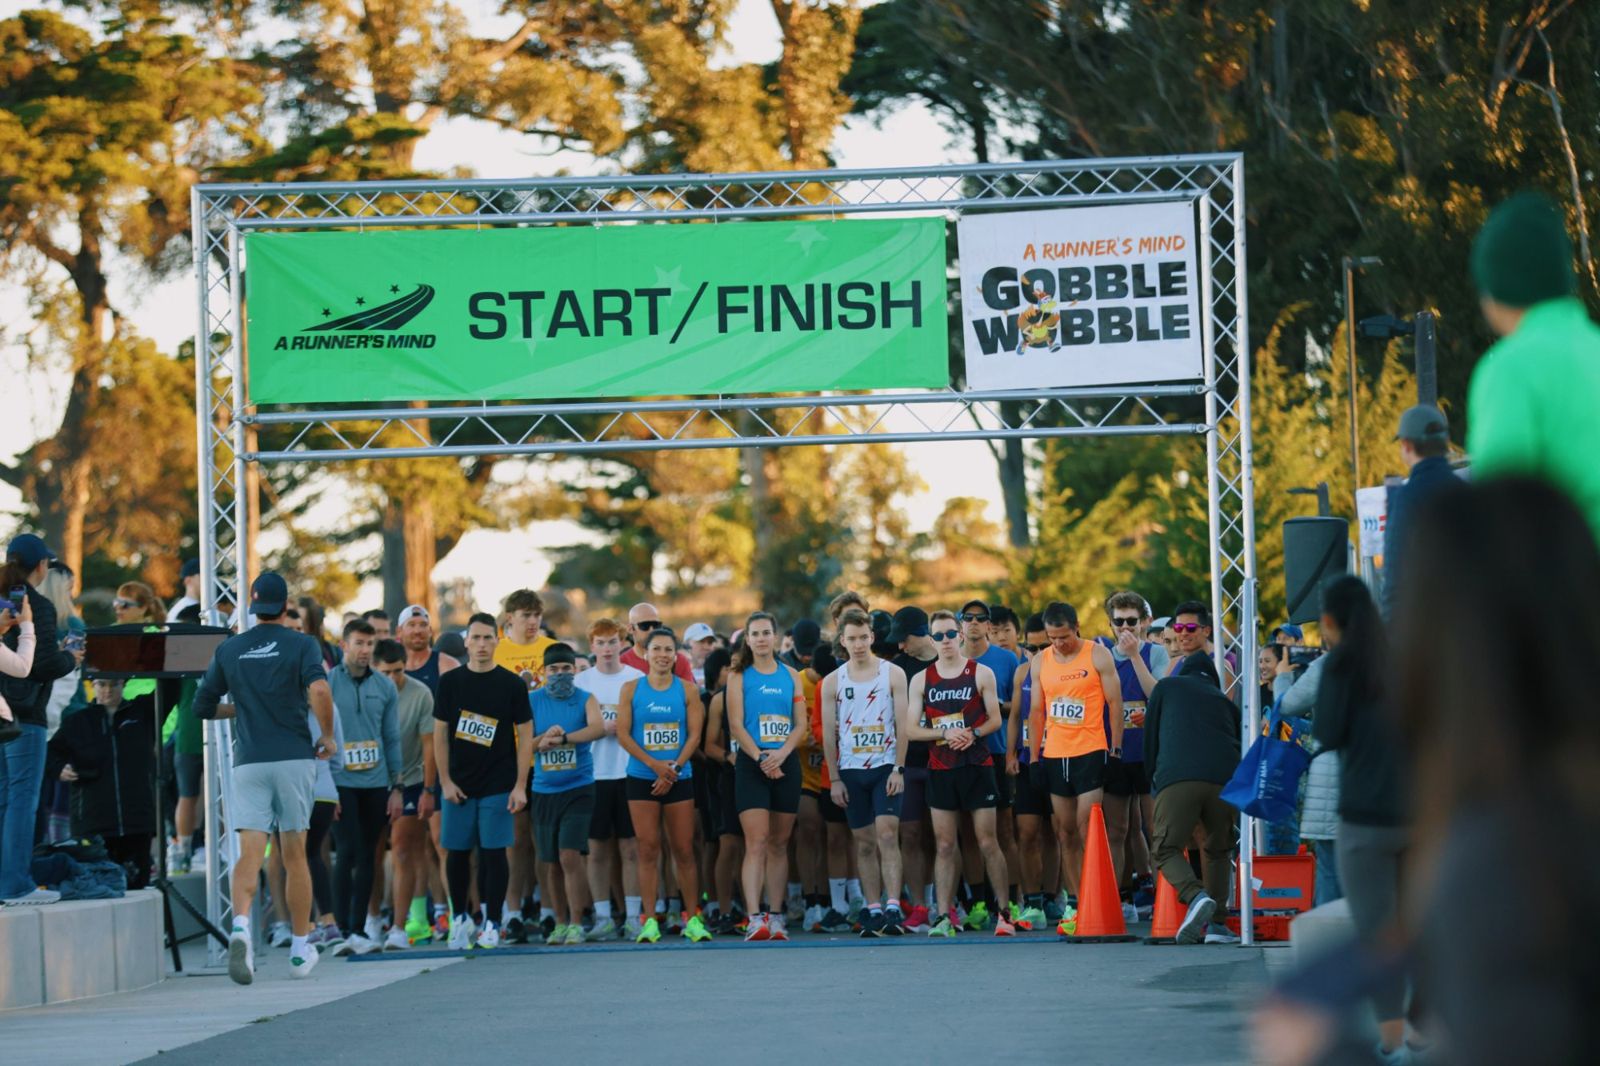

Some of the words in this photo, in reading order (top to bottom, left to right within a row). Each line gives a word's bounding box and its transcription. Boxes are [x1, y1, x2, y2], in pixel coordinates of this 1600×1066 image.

[1023, 242, 1037, 261] A
[1042, 236, 1134, 260] RUNNER'S
[1139, 235, 1186, 254] MIND
[981, 261, 1188, 311] GOBBLE
[467, 279, 922, 344] START/FINISH
[274, 336, 288, 351] A
[290, 334, 386, 350] RUNNER'S
[387, 334, 437, 349] MIND
[928, 686, 972, 702] Cornell
[1051, 704, 1084, 718] 1162
[459, 719, 493, 740] 1065
[761, 721, 788, 736] 1092
[645, 731, 677, 744] 1058
[851, 733, 884, 747] 1247
[346, 748, 376, 763] 1131
[542, 750, 573, 765] 1087
